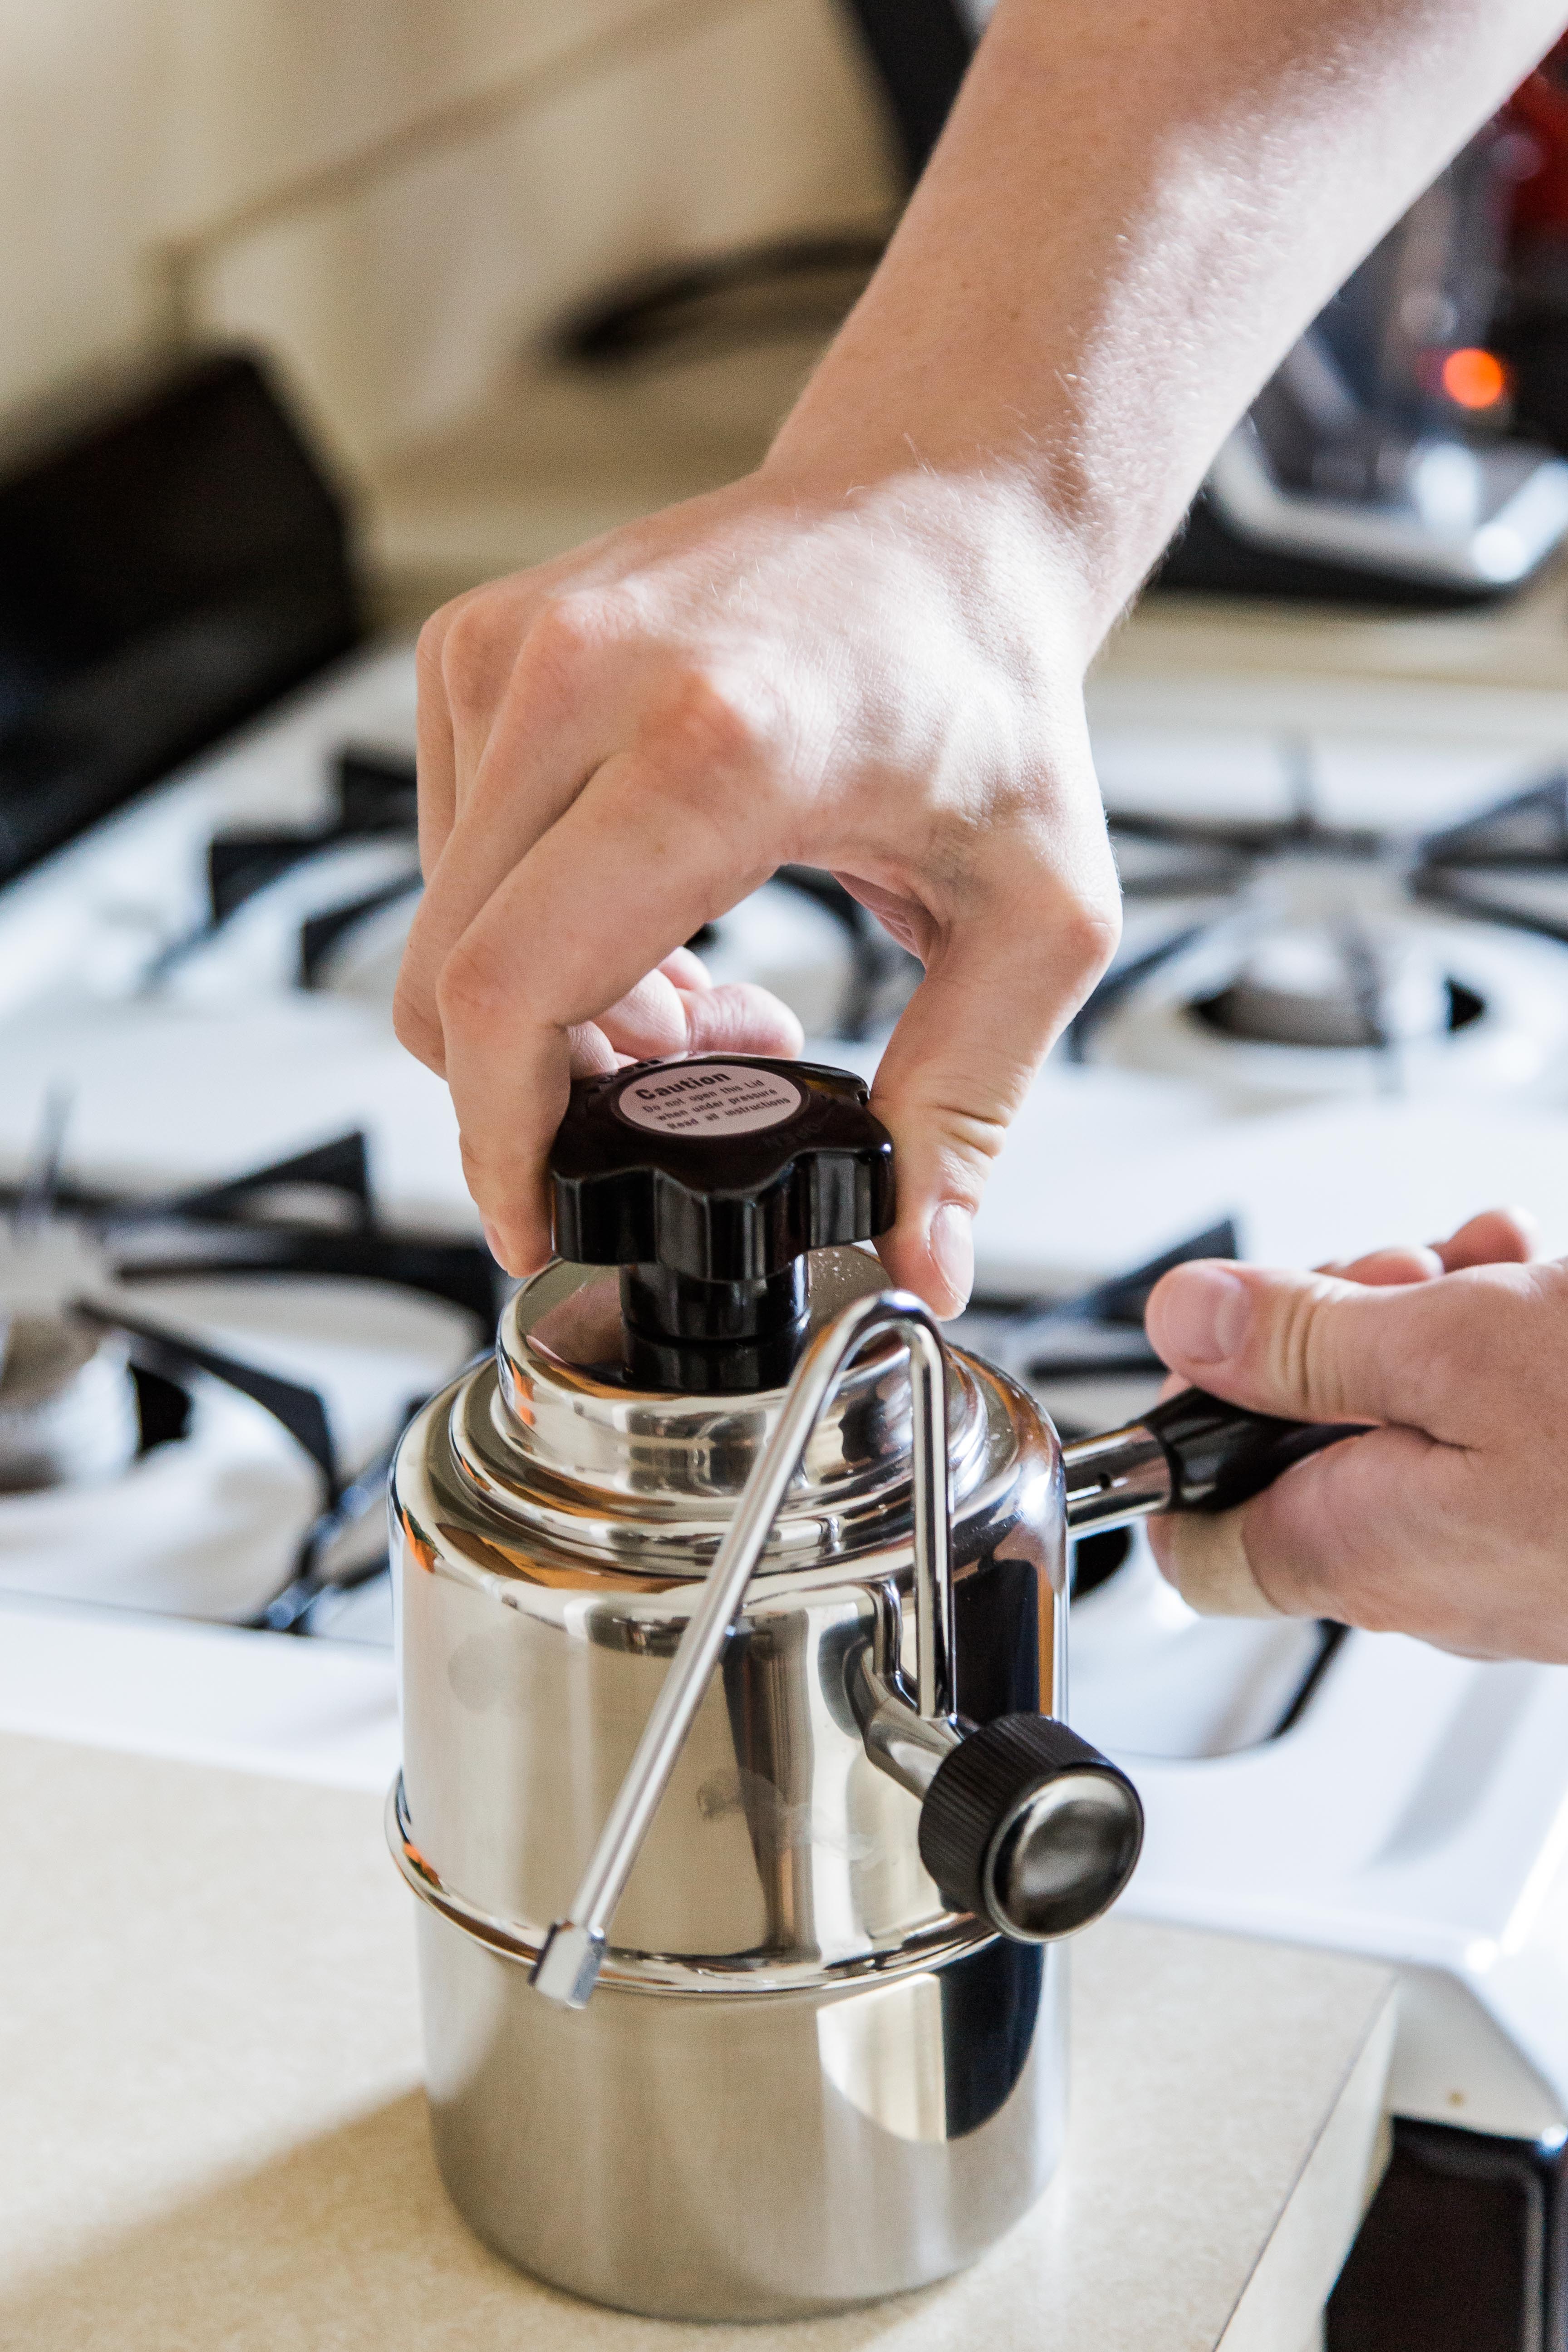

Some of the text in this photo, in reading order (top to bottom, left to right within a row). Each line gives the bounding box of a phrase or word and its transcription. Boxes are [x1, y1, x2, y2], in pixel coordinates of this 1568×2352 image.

[634, 1073, 732, 1100] Caution
[642, 1079, 765, 1113] Do not open this Lid
[656, 1089, 777, 1121] when under pressure
[666, 1118, 698, 1129] Read
[724, 1097, 790, 1117] instructions
